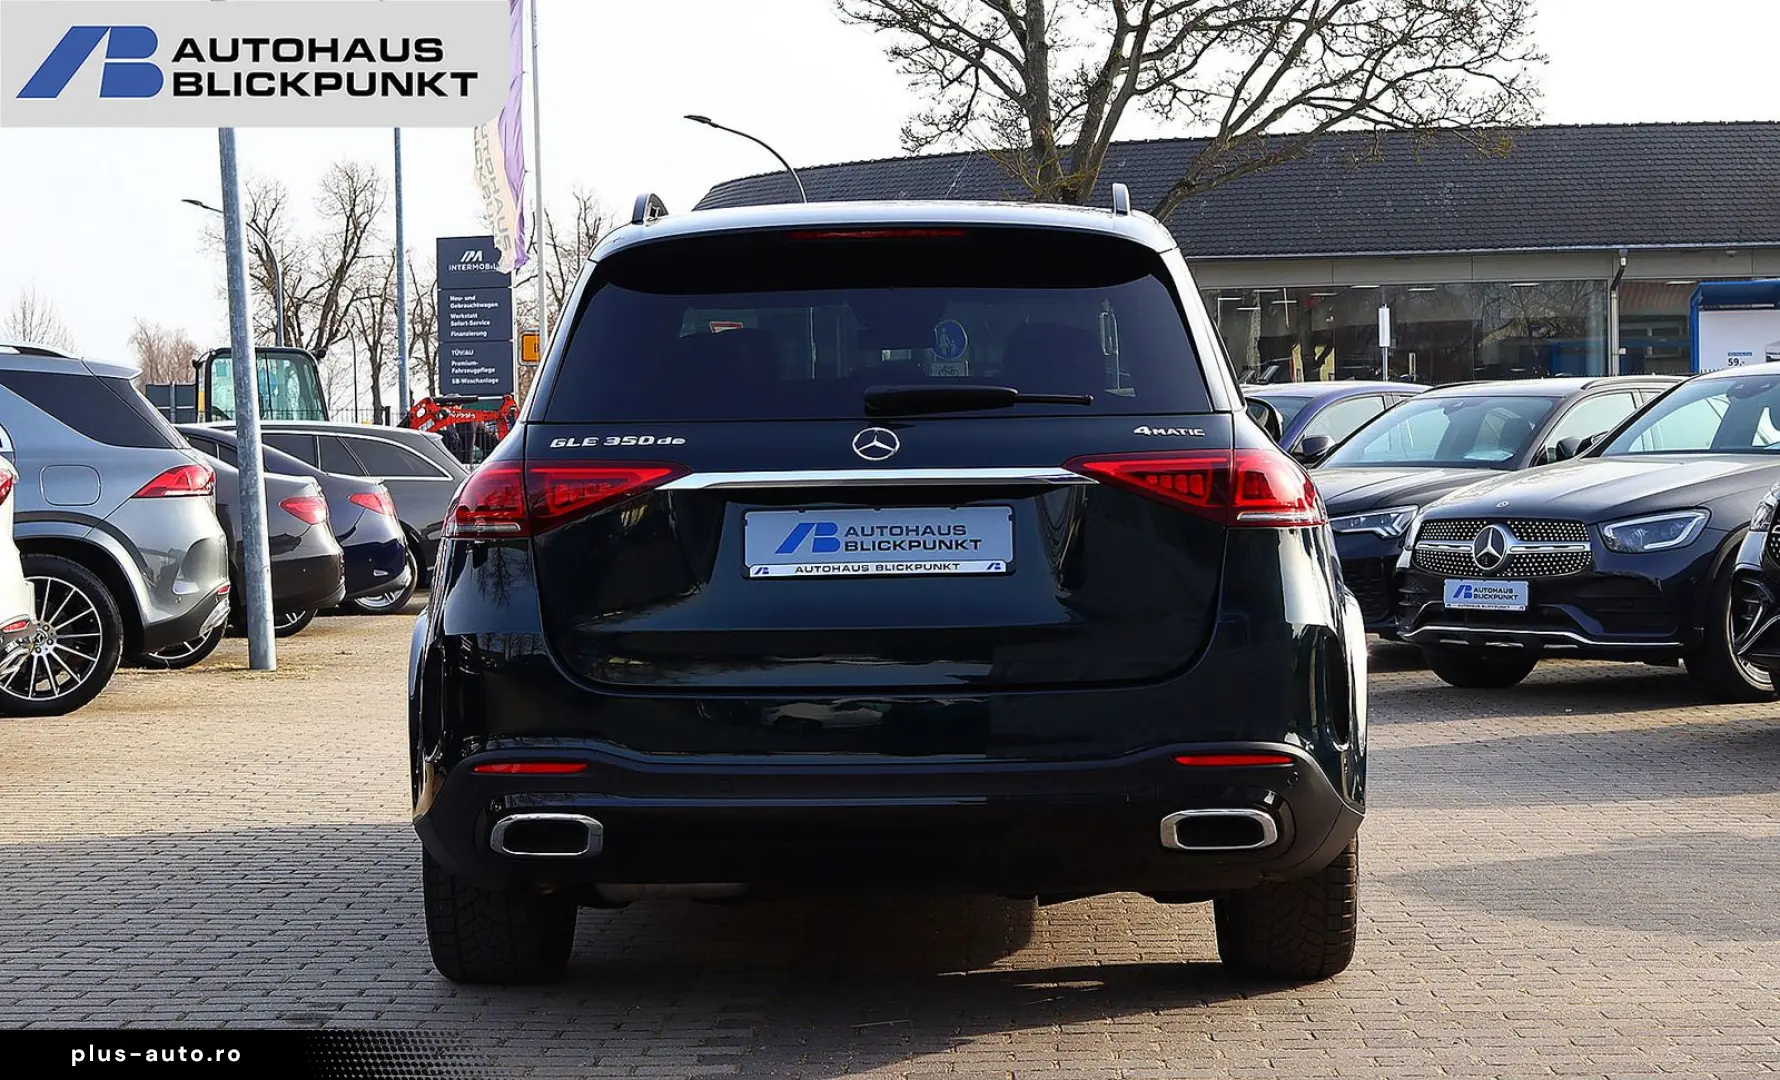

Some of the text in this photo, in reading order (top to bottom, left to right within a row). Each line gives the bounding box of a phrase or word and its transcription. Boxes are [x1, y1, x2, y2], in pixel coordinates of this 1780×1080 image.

[481, 123, 512, 251] UTOHAUS
[451, 367, 496, 375] Fahrzeugpflege
[1133, 425, 1206, 436] 4MATIC
[550, 435, 686, 448] GLE 350 de
[844, 525, 966, 537] AUTOHAUS
[844, 539, 982, 552] BLICKPUNKT
[795, 563, 960, 574] AUTOHAUS BLICKPUNKT
